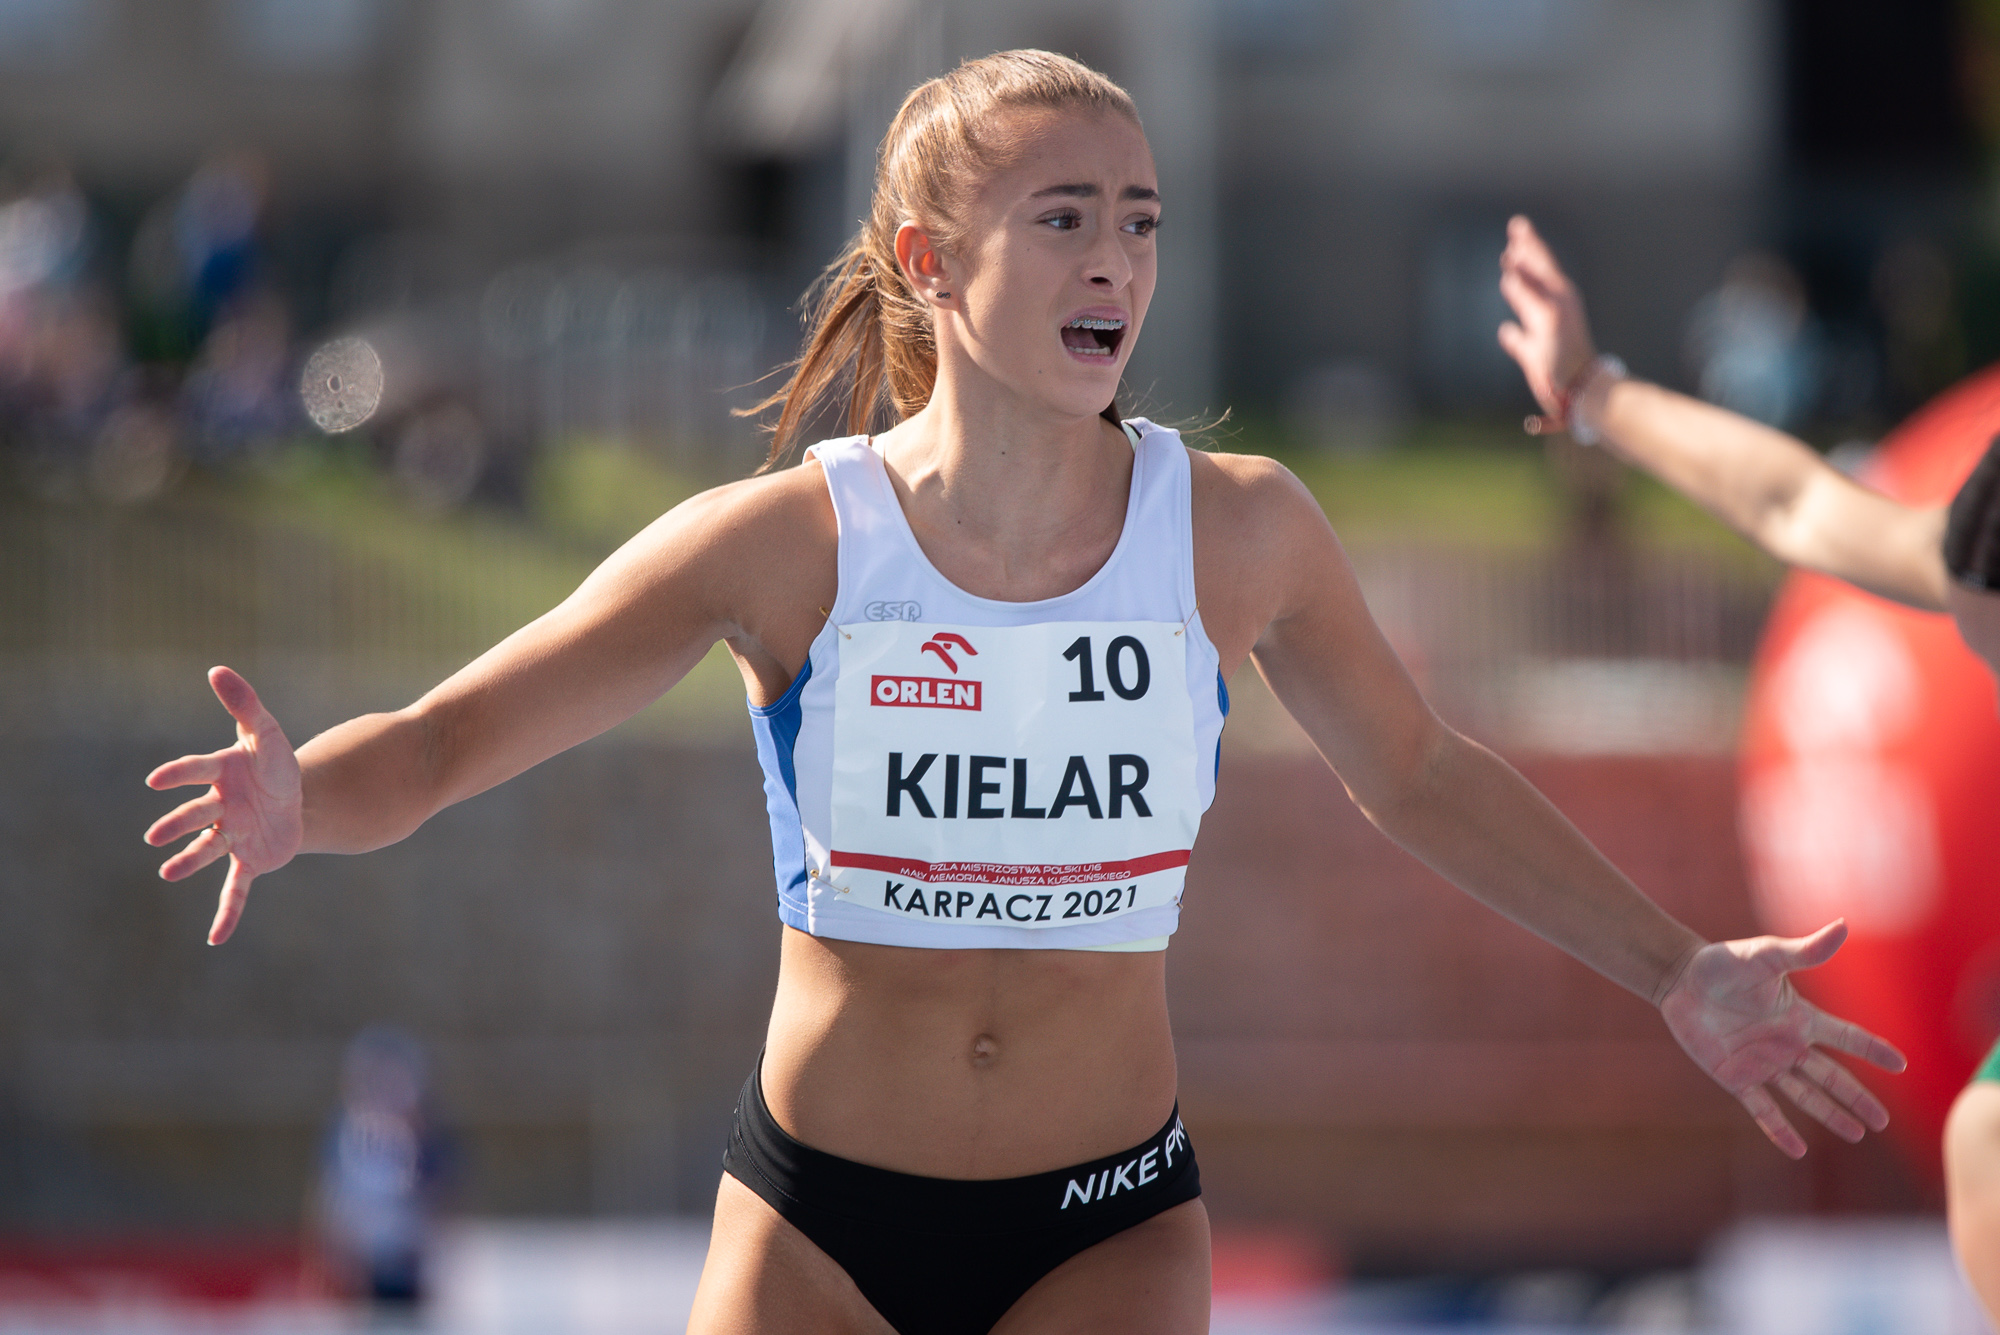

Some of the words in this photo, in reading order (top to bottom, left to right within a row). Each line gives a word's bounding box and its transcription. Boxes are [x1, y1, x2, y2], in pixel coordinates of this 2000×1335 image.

[1062, 635, 1151, 703] 10
[875, 679, 976, 707] ORLEN
[886, 752, 1153, 820] KIELAR
[928, 873, 989, 882] MEMORIAŁ
[992, 875, 1045, 885] JANUSZA
[1047, 870, 1131, 886] KUSOCIŃSKIEGO
[929, 863, 958, 872] PZLA
[960, 863, 1041, 875] MISTRZOSTWA
[1043, 865, 1081, 875] POLSKI
[1083, 863, 1102, 873] U16
[884, 880, 1053, 922] KARPACZ
[1062, 884, 1137, 919] 2021
[1060, 1146, 1159, 1210] NIKE
[1165, 1113, 1185, 1168] PR
